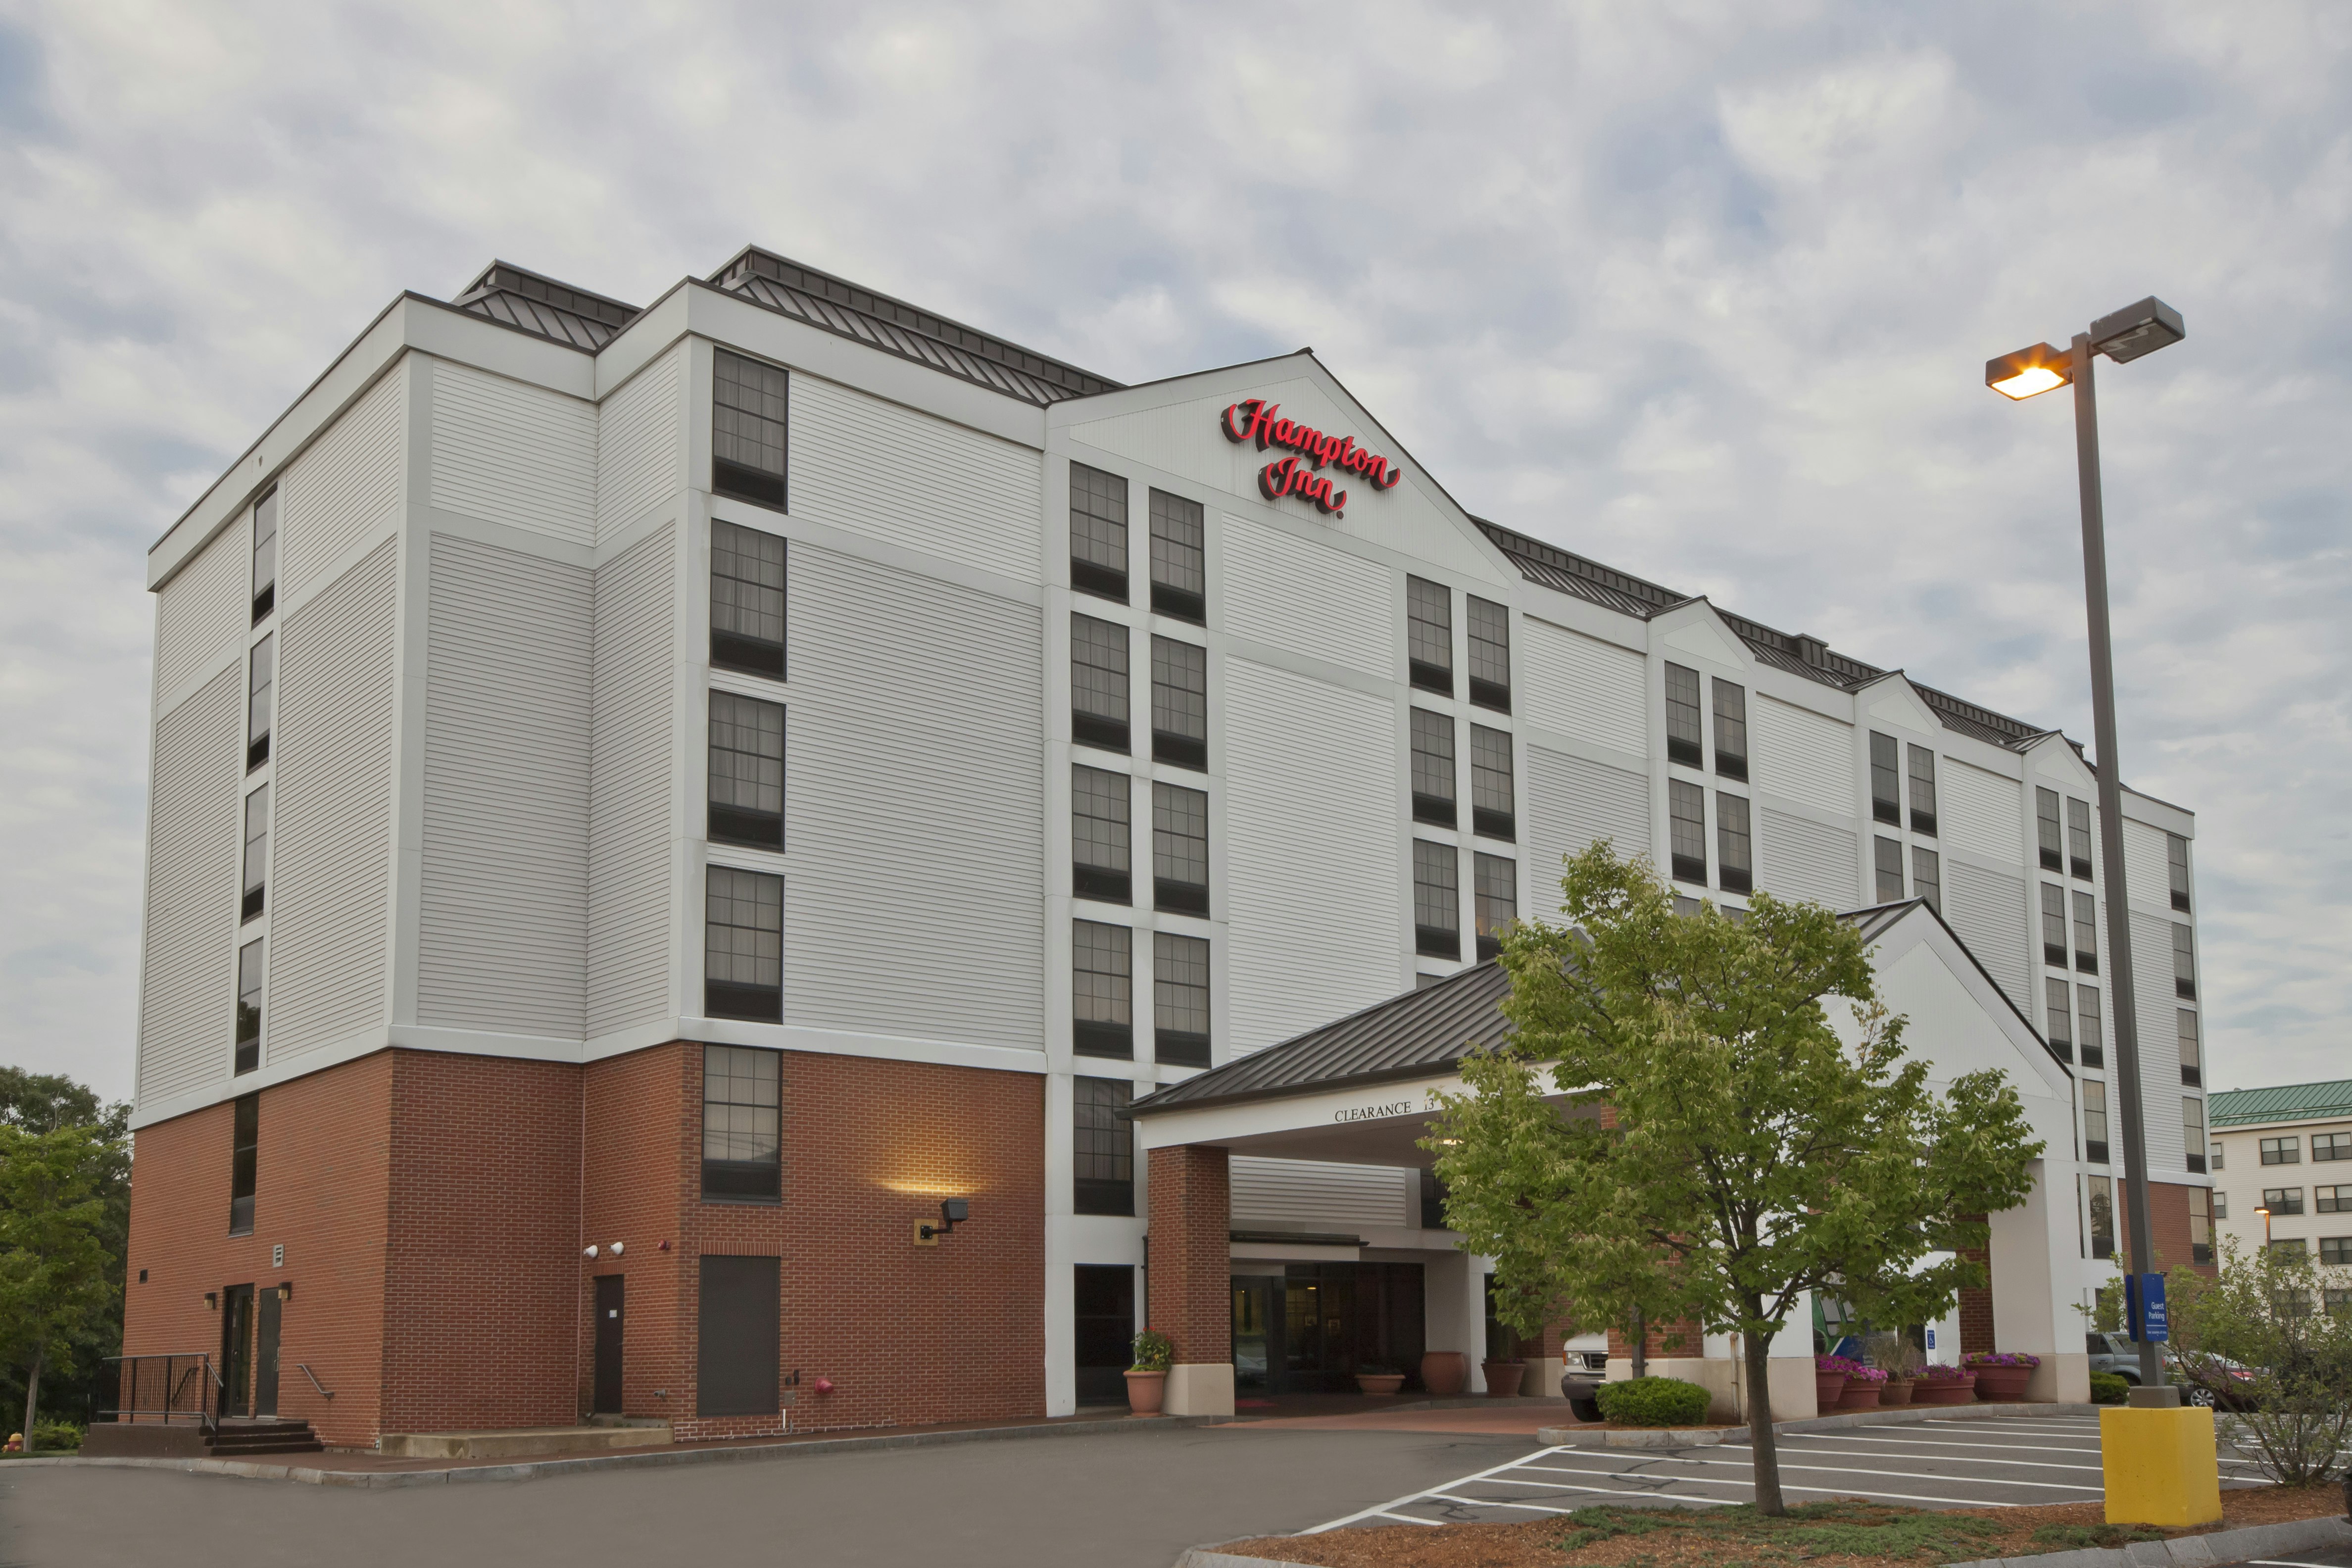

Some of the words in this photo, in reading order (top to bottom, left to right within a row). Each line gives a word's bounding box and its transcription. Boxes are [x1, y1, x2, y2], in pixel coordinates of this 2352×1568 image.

[1221, 399, 1400, 490] Hampton
[1334, 1101, 1412, 1122] CLEARANCE
[2149, 1312, 2165, 1322] Parking
